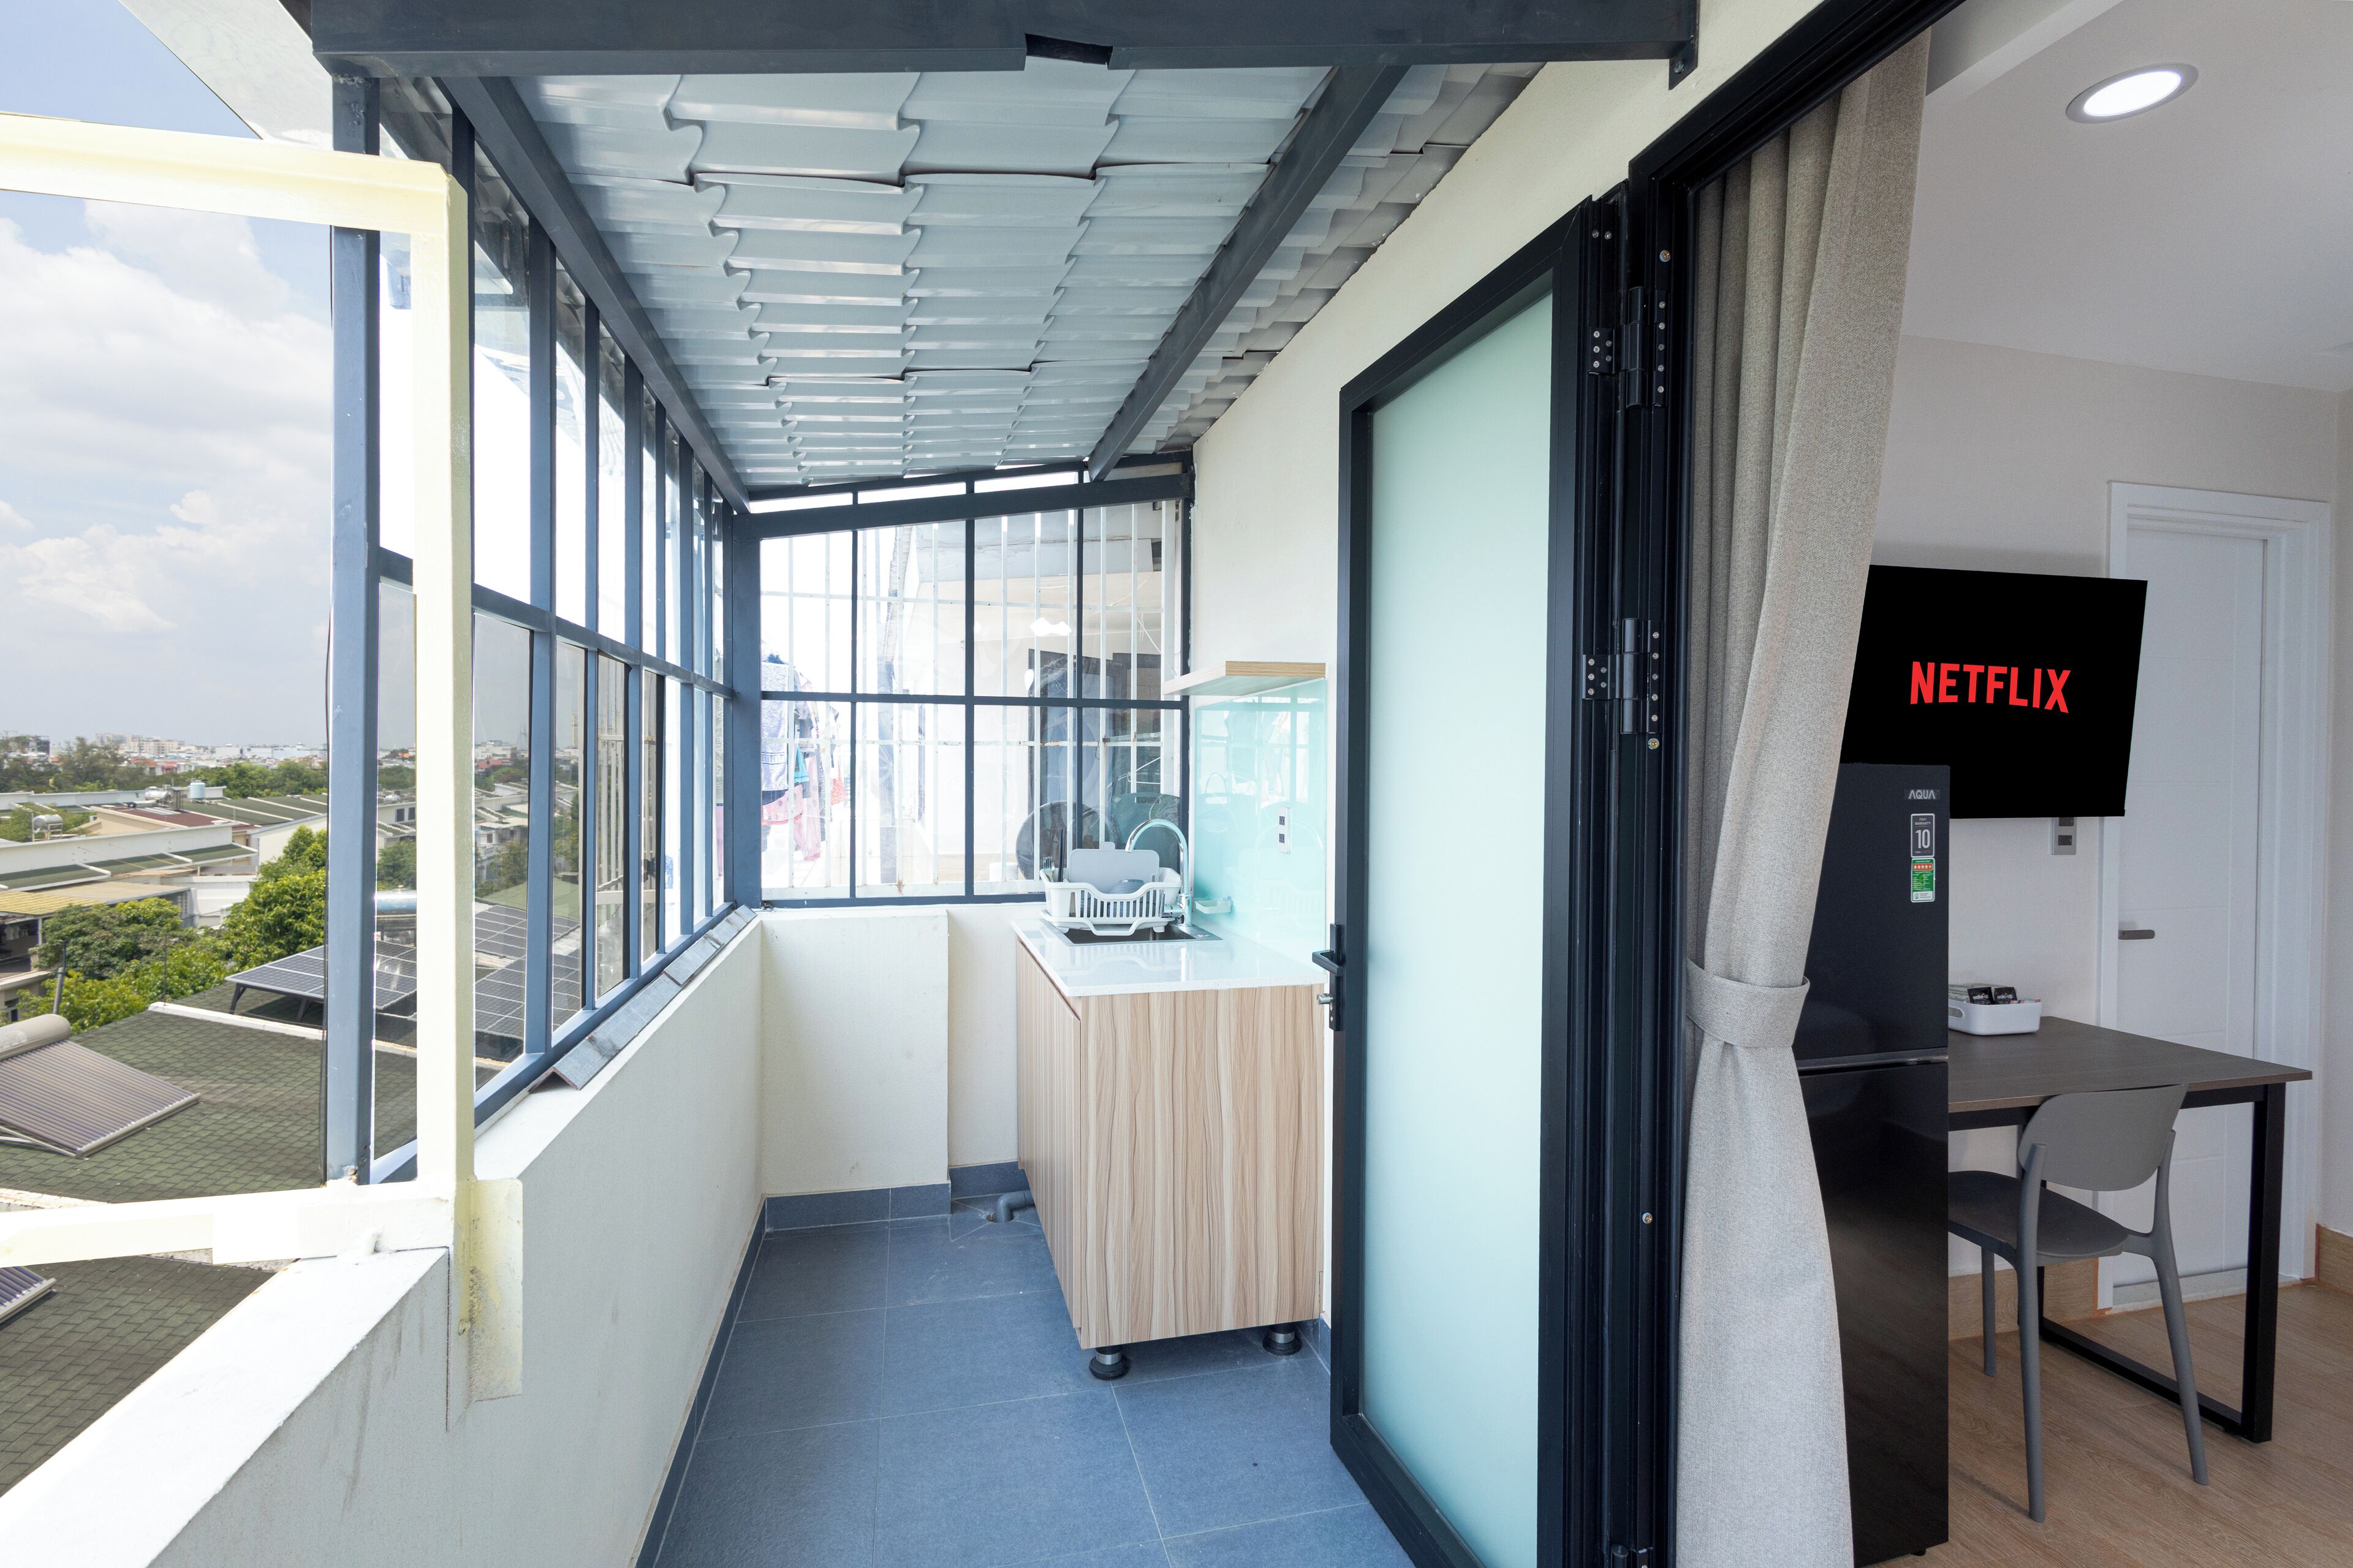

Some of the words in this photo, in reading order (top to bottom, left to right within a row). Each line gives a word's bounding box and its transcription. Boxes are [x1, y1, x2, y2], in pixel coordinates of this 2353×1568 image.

[1911, 661, 2071, 713] NETFLIX
[1908, 790, 1936, 800] AQUA
[1915, 829, 1930, 849] 10
